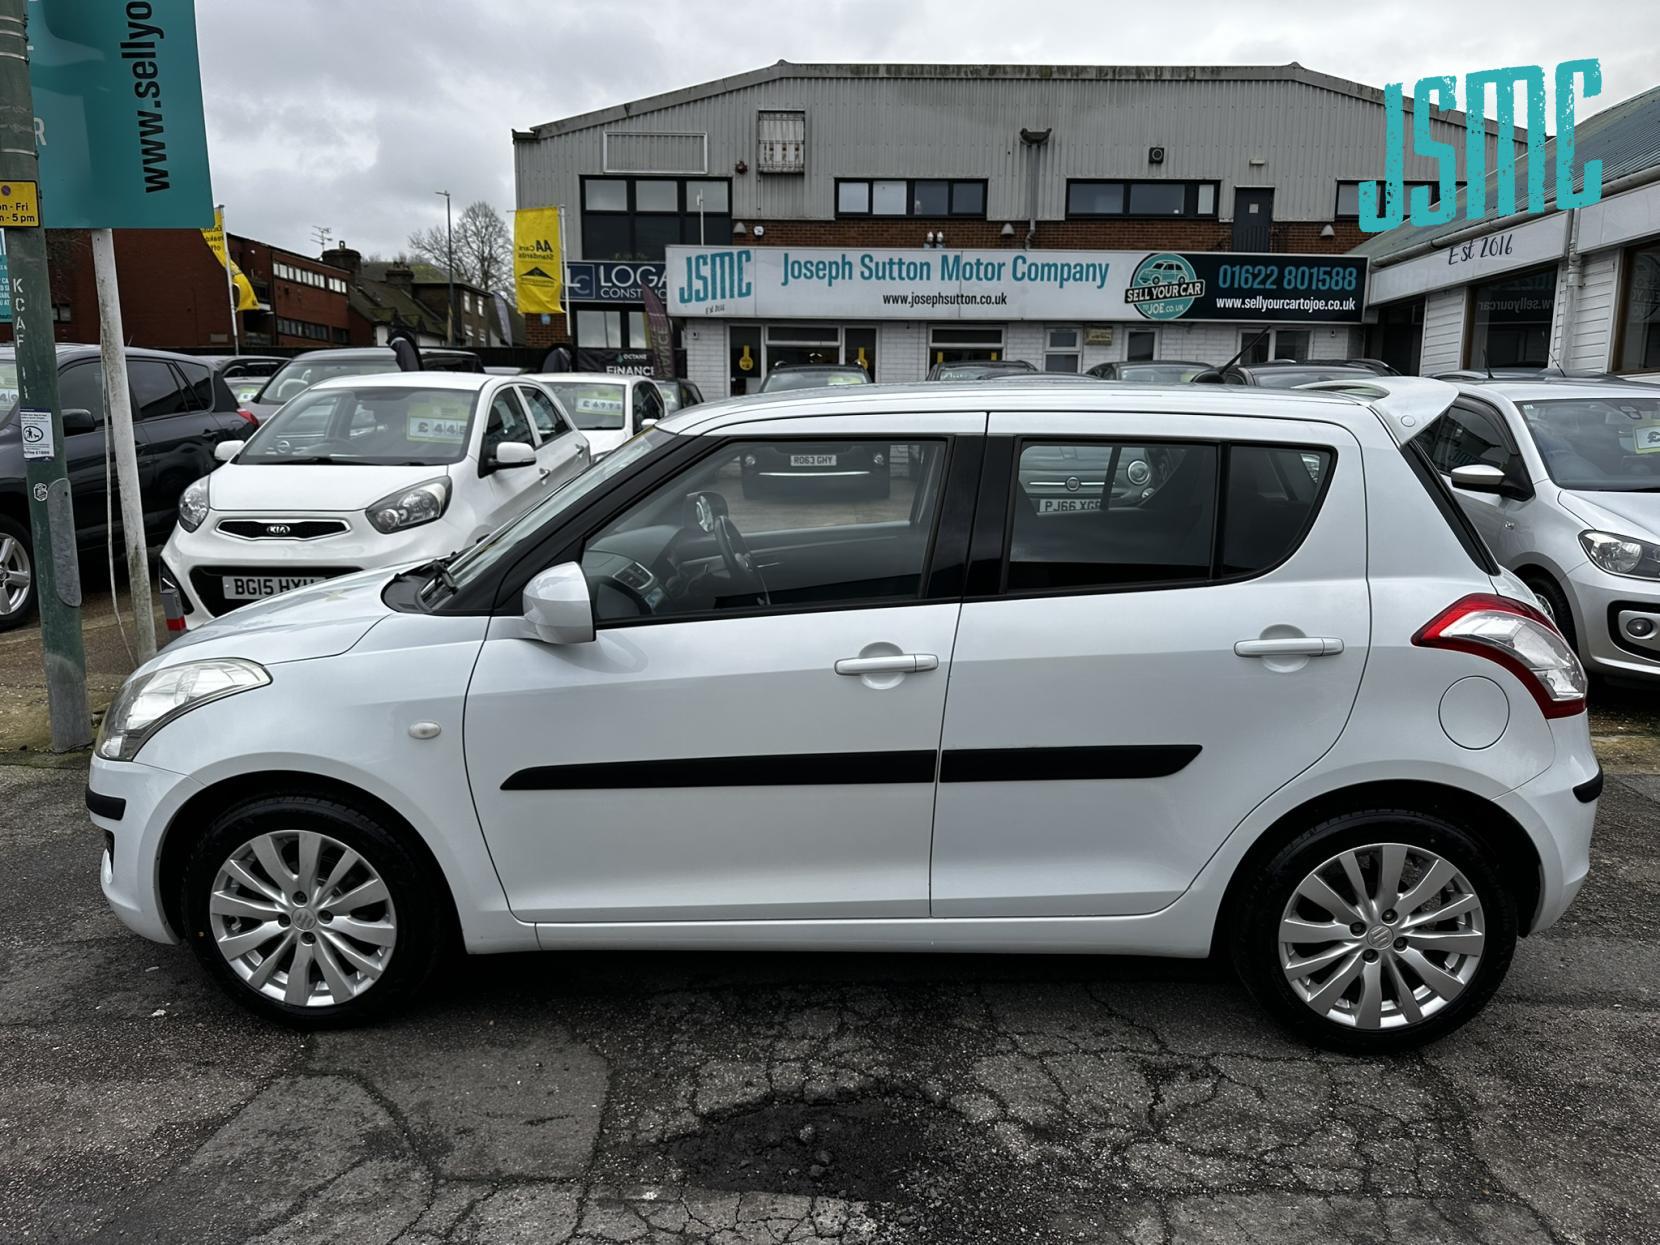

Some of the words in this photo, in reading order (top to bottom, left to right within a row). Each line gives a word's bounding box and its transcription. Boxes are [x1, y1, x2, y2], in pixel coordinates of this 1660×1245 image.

[1449, 239, 1475, 265] Est
[1480, 234, 1513, 258] 2016
[679, 250, 752, 304] JSMC
[781, 252, 853, 287] Joseph
[860, 254, 931, 281] Sutton
[940, 254, 1006, 282] Motor
[1011, 255, 1110, 290] Company
[1219, 264, 1278, 289] 01622
[1283, 266, 1357, 290] 801588
[883, 292, 1007, 309] www.josephsutton.co.uk
[1127, 289, 1150, 302] SELL
[1151, 285, 1179, 299] YOUR
[1180, 283, 1202, 296] CAR
[1216, 296, 1356, 313] www.sellyourcartojoe.co.uk
[1045, 501, 1076, 512] PJ66
[269, 526, 289, 534] KIA
[234, 579, 274, 595] BG15
